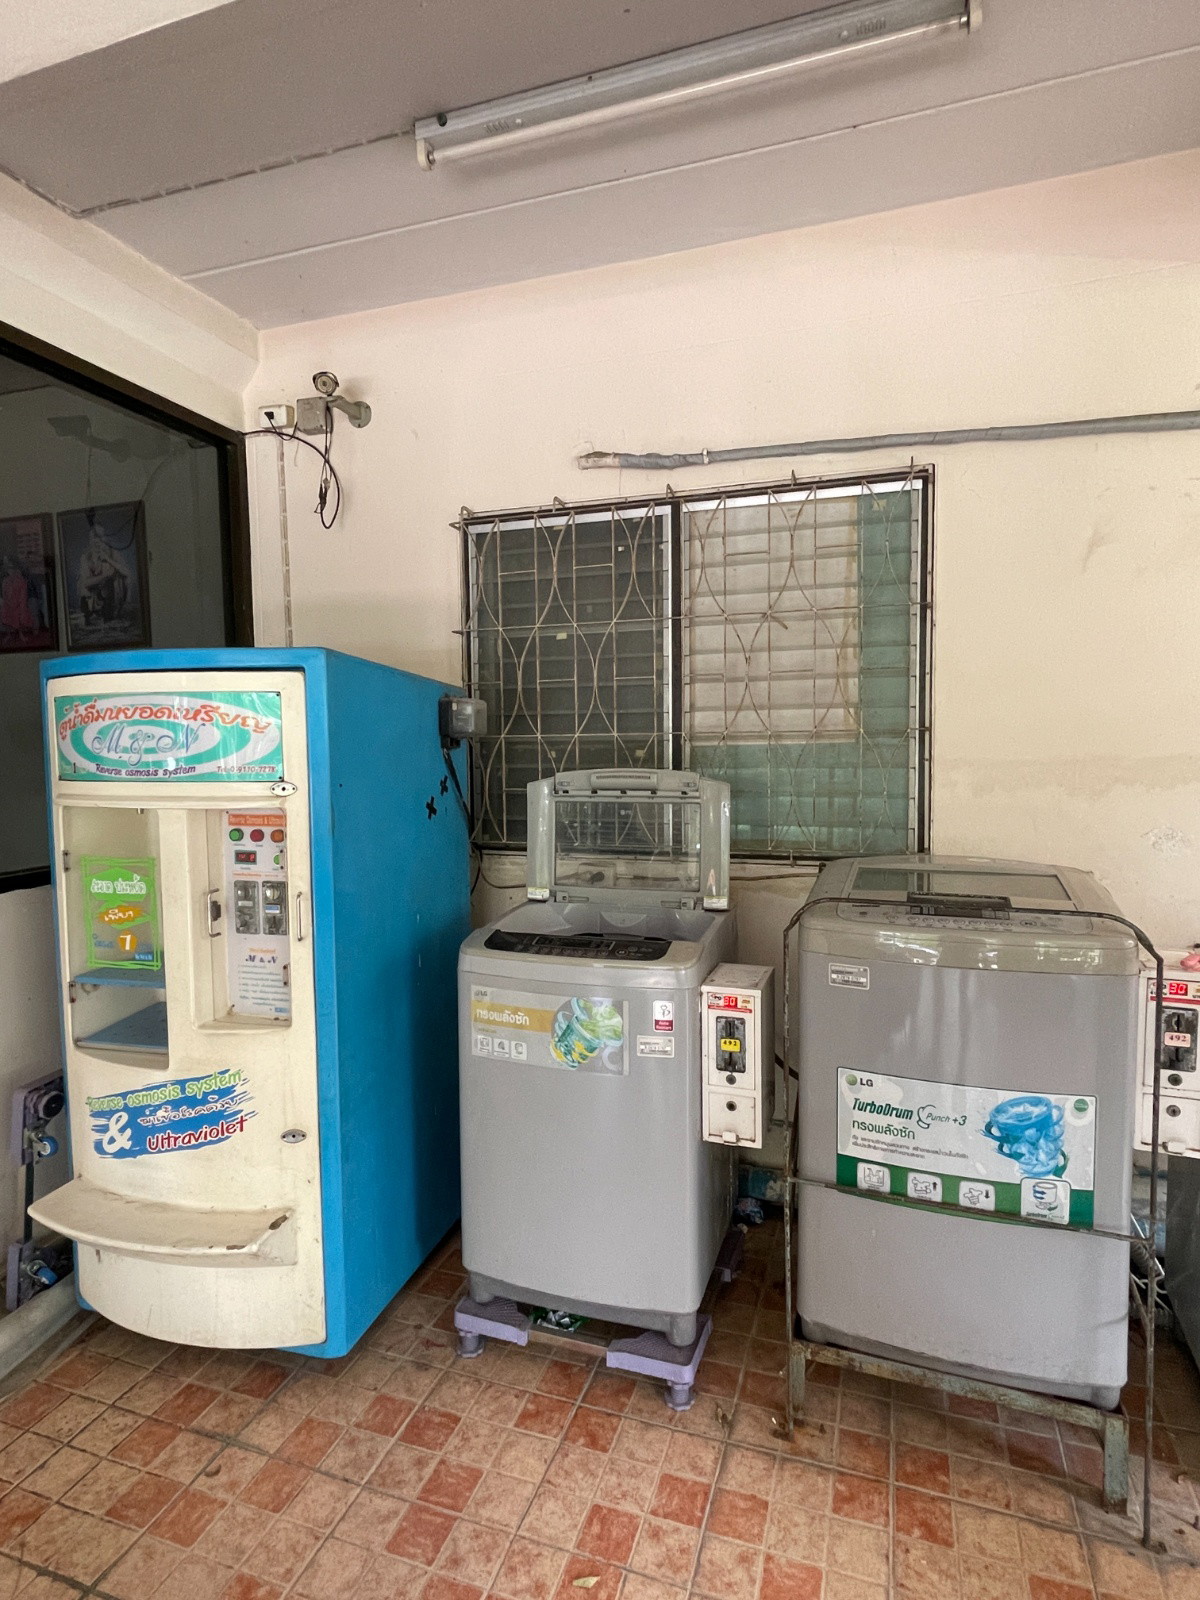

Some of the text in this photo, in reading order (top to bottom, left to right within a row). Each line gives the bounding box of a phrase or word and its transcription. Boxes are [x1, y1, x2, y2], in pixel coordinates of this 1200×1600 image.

[95, 763, 196, 778] Reverse osmosis system
[1169, 982, 1187, 995] 30
[1168, 1034, 1187, 1042] 492
[126, 1085, 181, 1108] osmosis
[185, 1067, 242, 1099] system
[860, 1077, 874, 1088] LG
[852, 1097, 914, 1121] TurboDrum
[925, 1112, 951, 1123] Punch
[103, 1111, 132, 1154] &
[147, 1115, 248, 1152] Ultraviolet
[851, 1119, 916, 1140] ทรงพลังซัก
